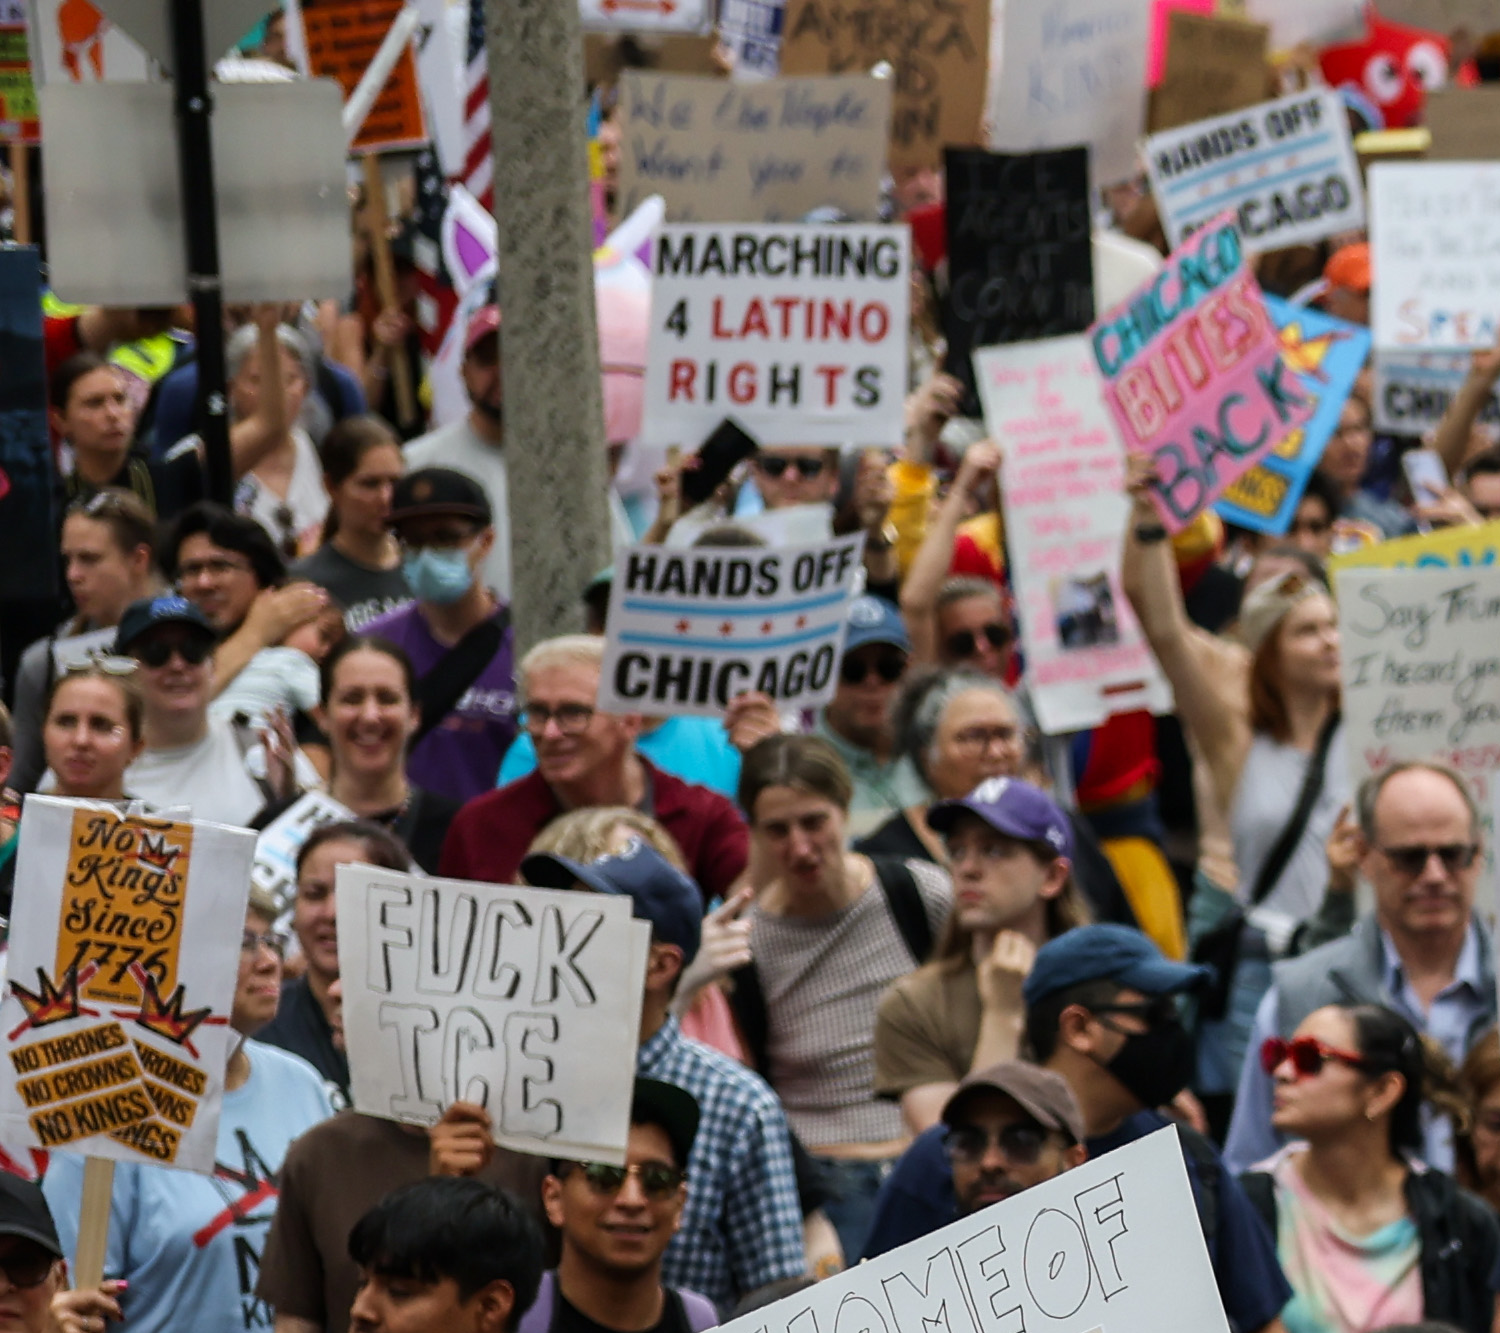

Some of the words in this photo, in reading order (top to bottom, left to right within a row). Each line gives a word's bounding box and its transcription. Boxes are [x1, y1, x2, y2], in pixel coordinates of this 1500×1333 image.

[657, 233, 900, 279] MARCHING
[666, 301, 688, 339] 4
[710, 298, 889, 342] LATINO
[1090, 224, 1243, 380] CHICAGO
[667, 356, 882, 409] RIGHTS
[1112, 288, 1270, 443] BITES
[1152, 354, 1308, 520] BACK
[625, 552, 779, 597] HANDS
[791, 543, 856, 592] OFF
[1347, 580, 1430, 650] Say
[613, 643, 837, 703] CHICAGO
[1384, 650, 1452, 689] heard
[1372, 692, 1439, 740] them
[77, 817, 136, 854] No
[67, 858, 184, 910] Kings
[64, 895, 178, 946] Since
[366, 880, 605, 1007] FUCK
[67, 934, 170, 995] 1776
[11, 1048, 45, 1077] NO
[42, 1023, 125, 1065] THRONES
[378, 1003, 566, 1138] ICE
[25, 1084, 59, 1110] NO
[58, 1054, 141, 1100] CROWNS
[37, 1110, 81, 1150] NO
[83, 1089, 153, 1135] KINGS
[1022, 1170, 1132, 1320] OF
